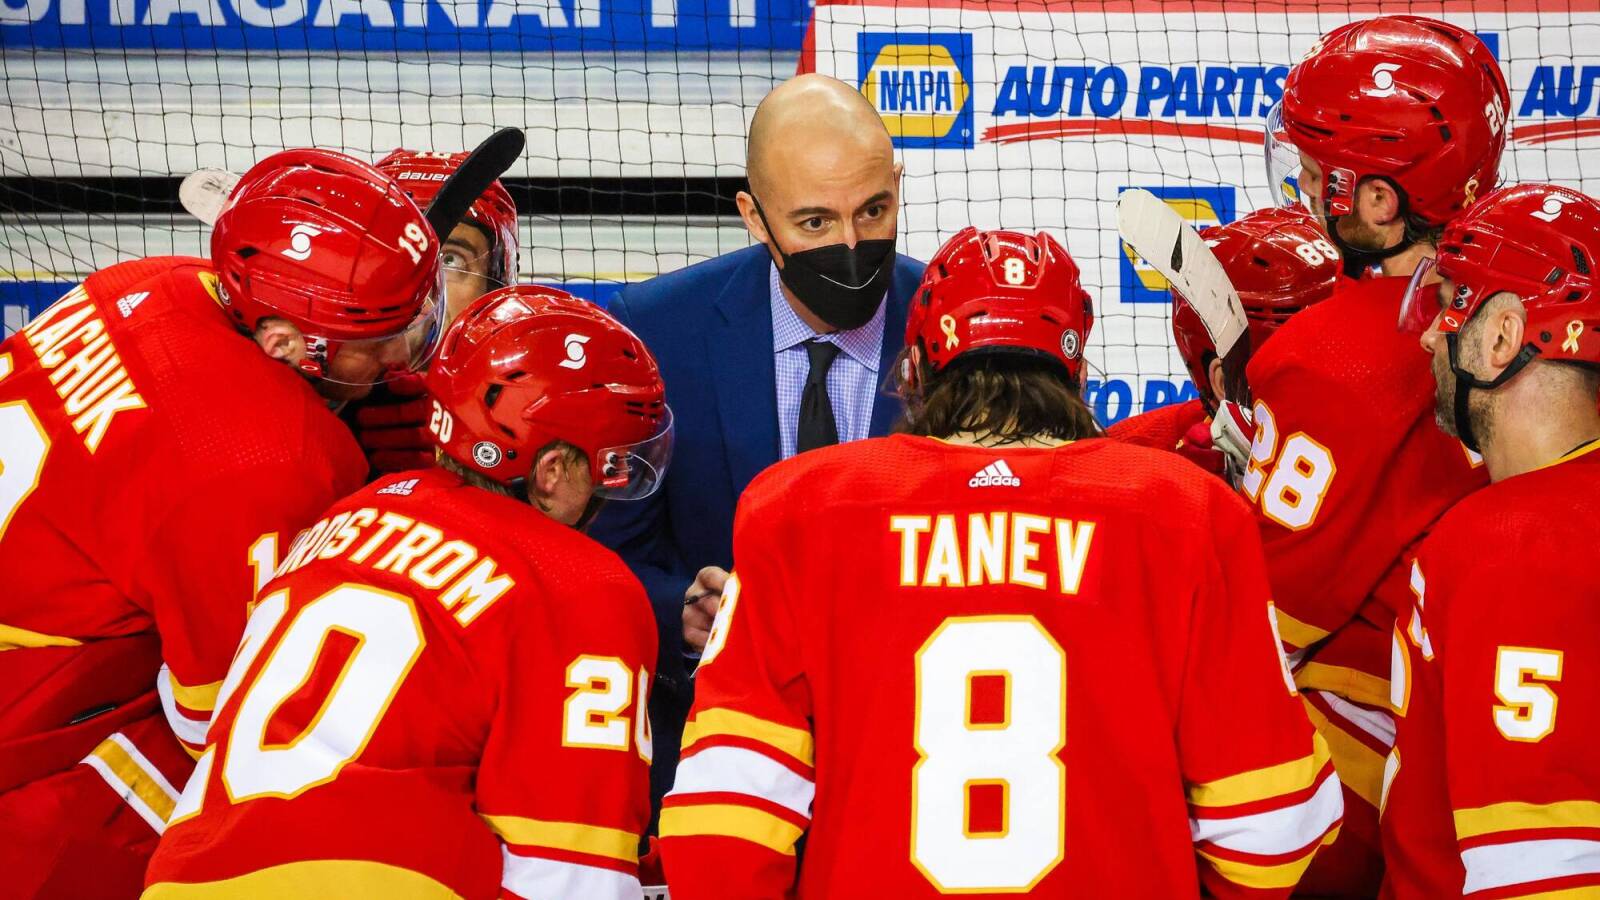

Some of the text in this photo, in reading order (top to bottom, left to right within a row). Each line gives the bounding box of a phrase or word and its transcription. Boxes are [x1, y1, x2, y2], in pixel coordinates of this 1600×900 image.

[880, 71, 952, 111] NAPA
[991, 66, 1289, 118] AUTO PARTS
[1518, 66, 1600, 117] AU
[1485, 93, 1504, 137] 28
[398, 223, 428, 265] 19
[1296, 240, 1340, 266] 88
[1004, 257, 1025, 285] 8
[429, 399, 453, 443] 20
[968, 475, 1021, 488] adidas
[1241, 399, 1337, 531] 28
[275, 507, 516, 628] RDSTROM
[890, 513, 1095, 594] TANEV
[1492, 646, 1564, 743] 5
[911, 614, 1066, 895] 8
